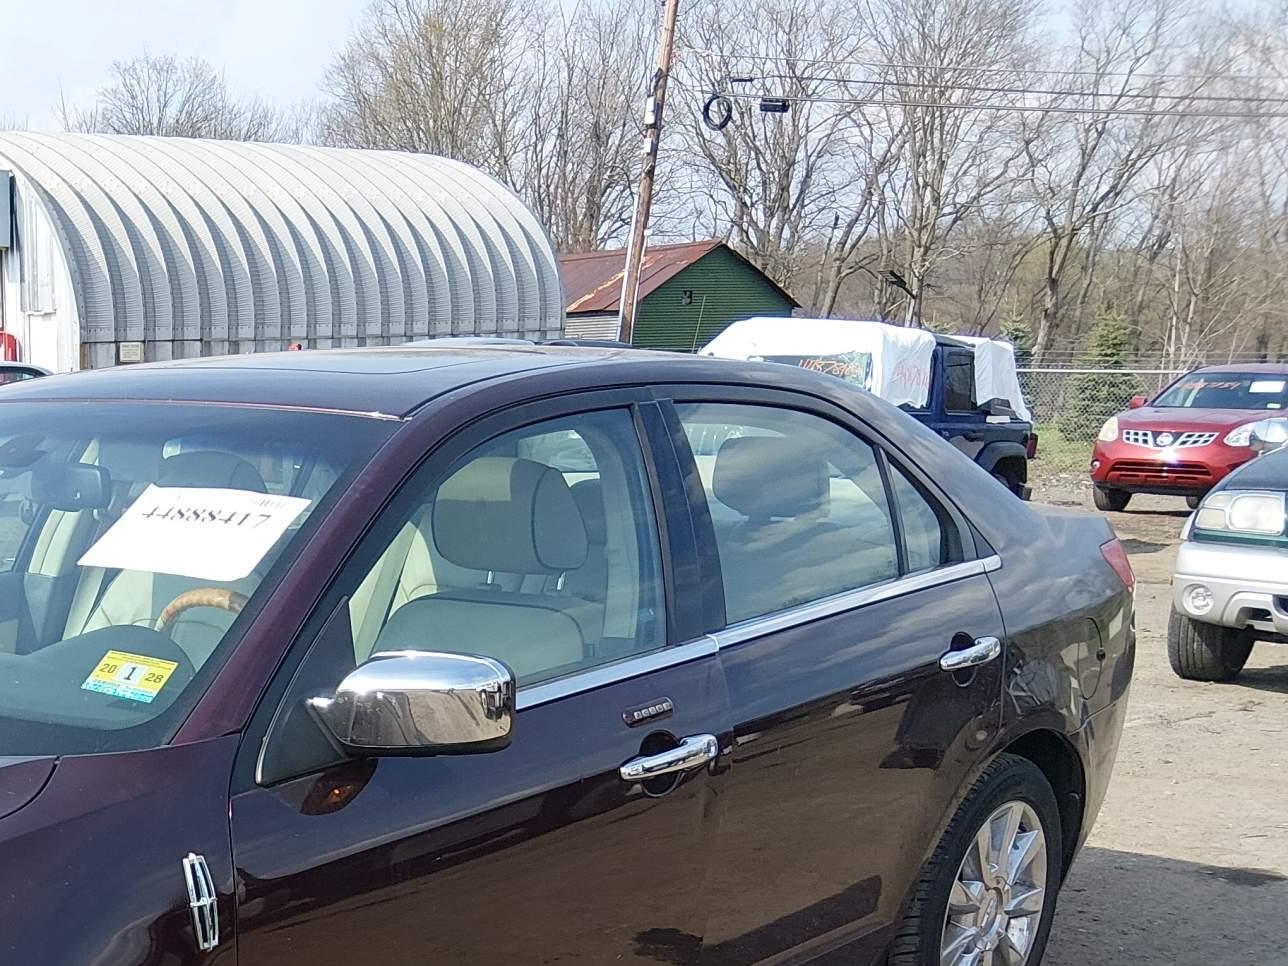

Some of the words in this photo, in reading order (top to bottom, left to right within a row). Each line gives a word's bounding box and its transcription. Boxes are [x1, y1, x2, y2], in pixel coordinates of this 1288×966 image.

[142, 506, 272, 528] 44888417
[99, 663, 118, 674] 20
[123, 666, 138, 681] 1
[144, 672, 164, 684] 28
